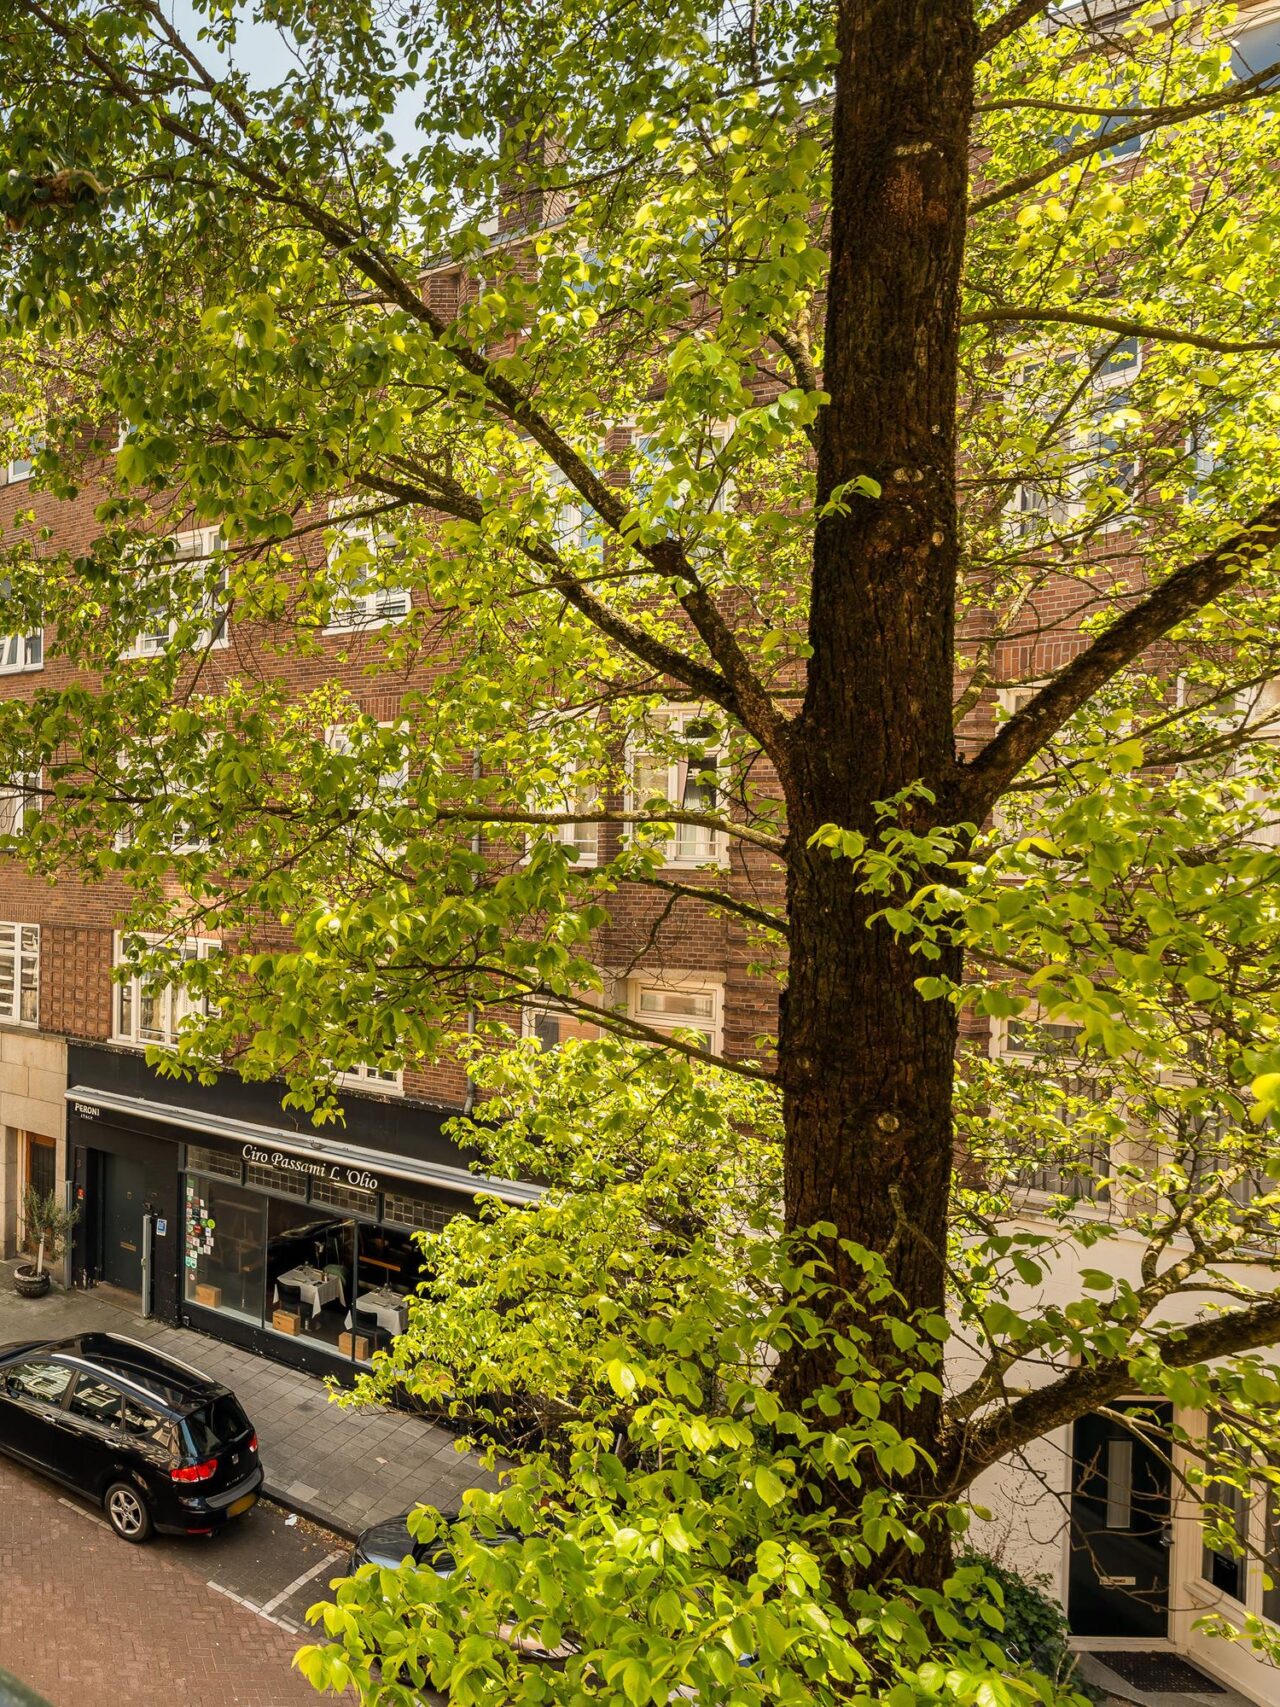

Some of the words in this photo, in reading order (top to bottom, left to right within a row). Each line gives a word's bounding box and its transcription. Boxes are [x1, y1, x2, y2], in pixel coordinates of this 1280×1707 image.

[75, 1102, 100, 1117] PERONI
[242, 1143, 268, 1163] Ciro
[271, 1152, 327, 1177] Passami
[328, 1166, 340, 1180] L
[346, 1169, 378, 1189] 'Olio
